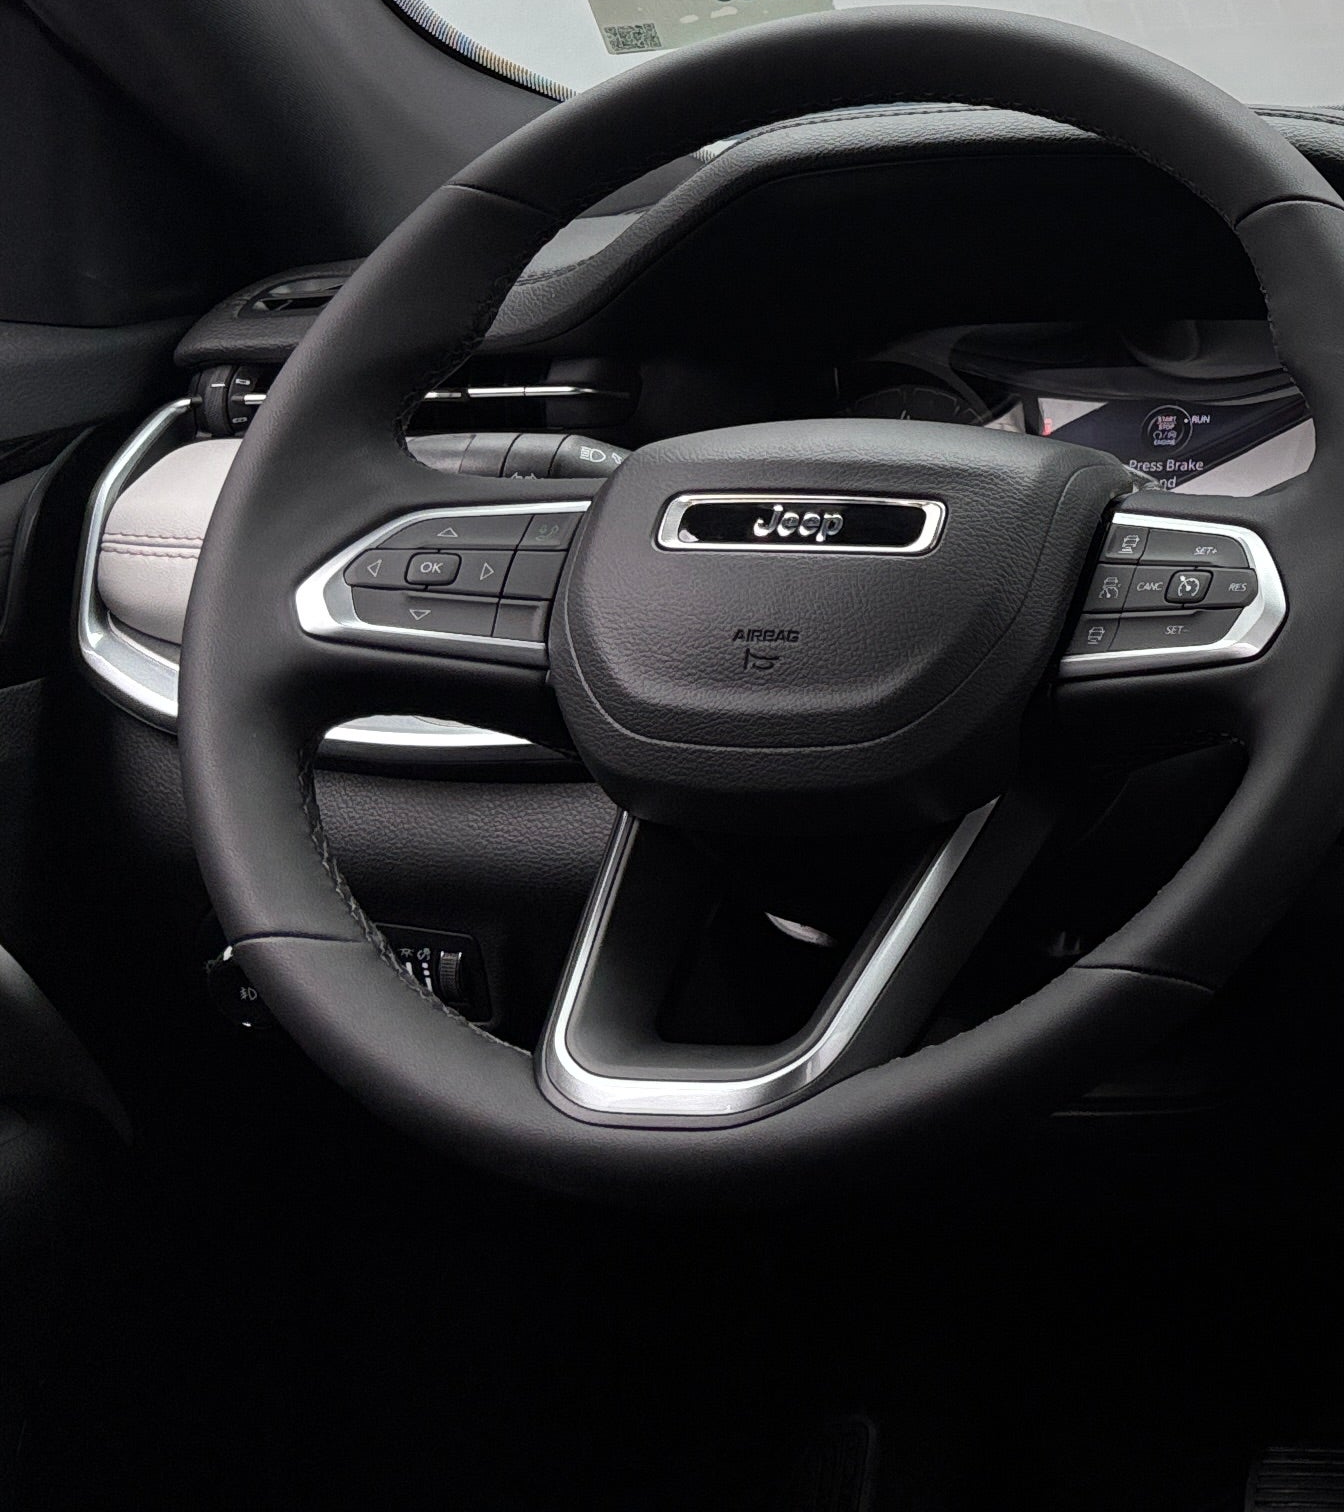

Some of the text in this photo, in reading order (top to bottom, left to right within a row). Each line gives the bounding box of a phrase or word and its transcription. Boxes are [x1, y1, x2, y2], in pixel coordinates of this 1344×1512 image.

[1192, 415, 1210, 423] RUN
[1129, 459, 1204, 471] Press Brake
[1160, 476, 1176, 488] nd
[753, 504, 843, 542] Jeep
[1194, 546, 1218, 556] SET+
[420, 562, 443, 573] OK
[1136, 581, 1164, 592] CANC
[1228, 582, 1247, 592] RES
[732, 628, 800, 643] AIRBAG
